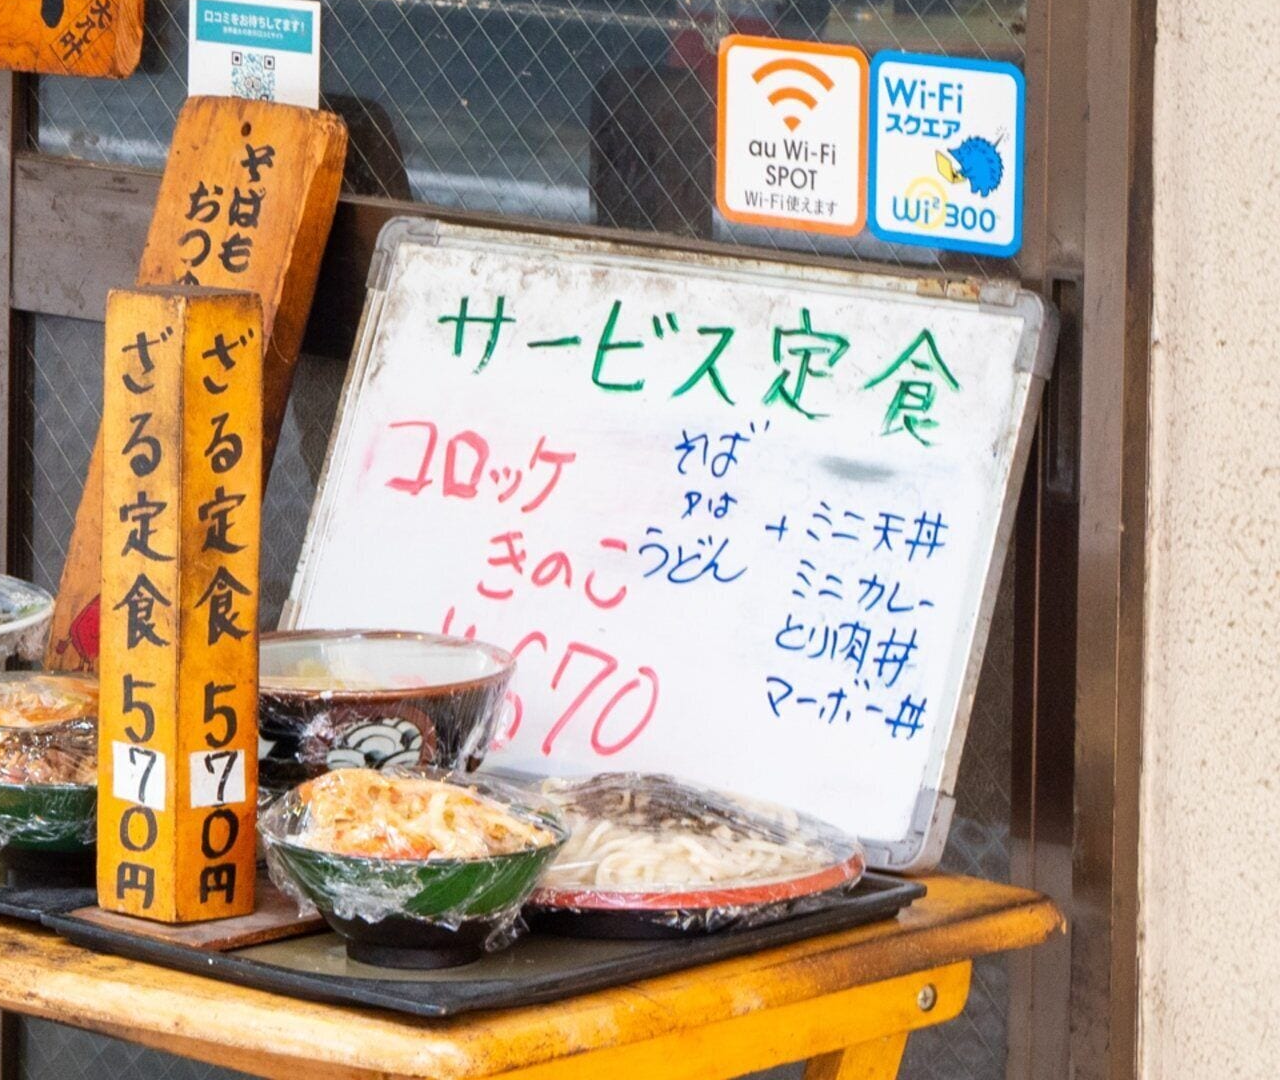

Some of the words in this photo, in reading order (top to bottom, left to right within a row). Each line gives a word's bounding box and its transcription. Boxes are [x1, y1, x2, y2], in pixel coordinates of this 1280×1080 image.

[884, 76, 964, 114] Wi-Fi
[885, 113, 961, 140] スクエア
[748, 142, 776, 159] au
[783, 139, 836, 165] Wi-Fi
[765, 165, 818, 190] SPOT
[744, 191, 838, 216] Wi-Fi使えます
[437, 295, 960, 447] サービス定食
[386, 420, 577, 513] コロッケ
[675, 419, 771, 478] そば
[476, 530, 628, 610] きのこ
[639, 526, 748, 584] うどん
